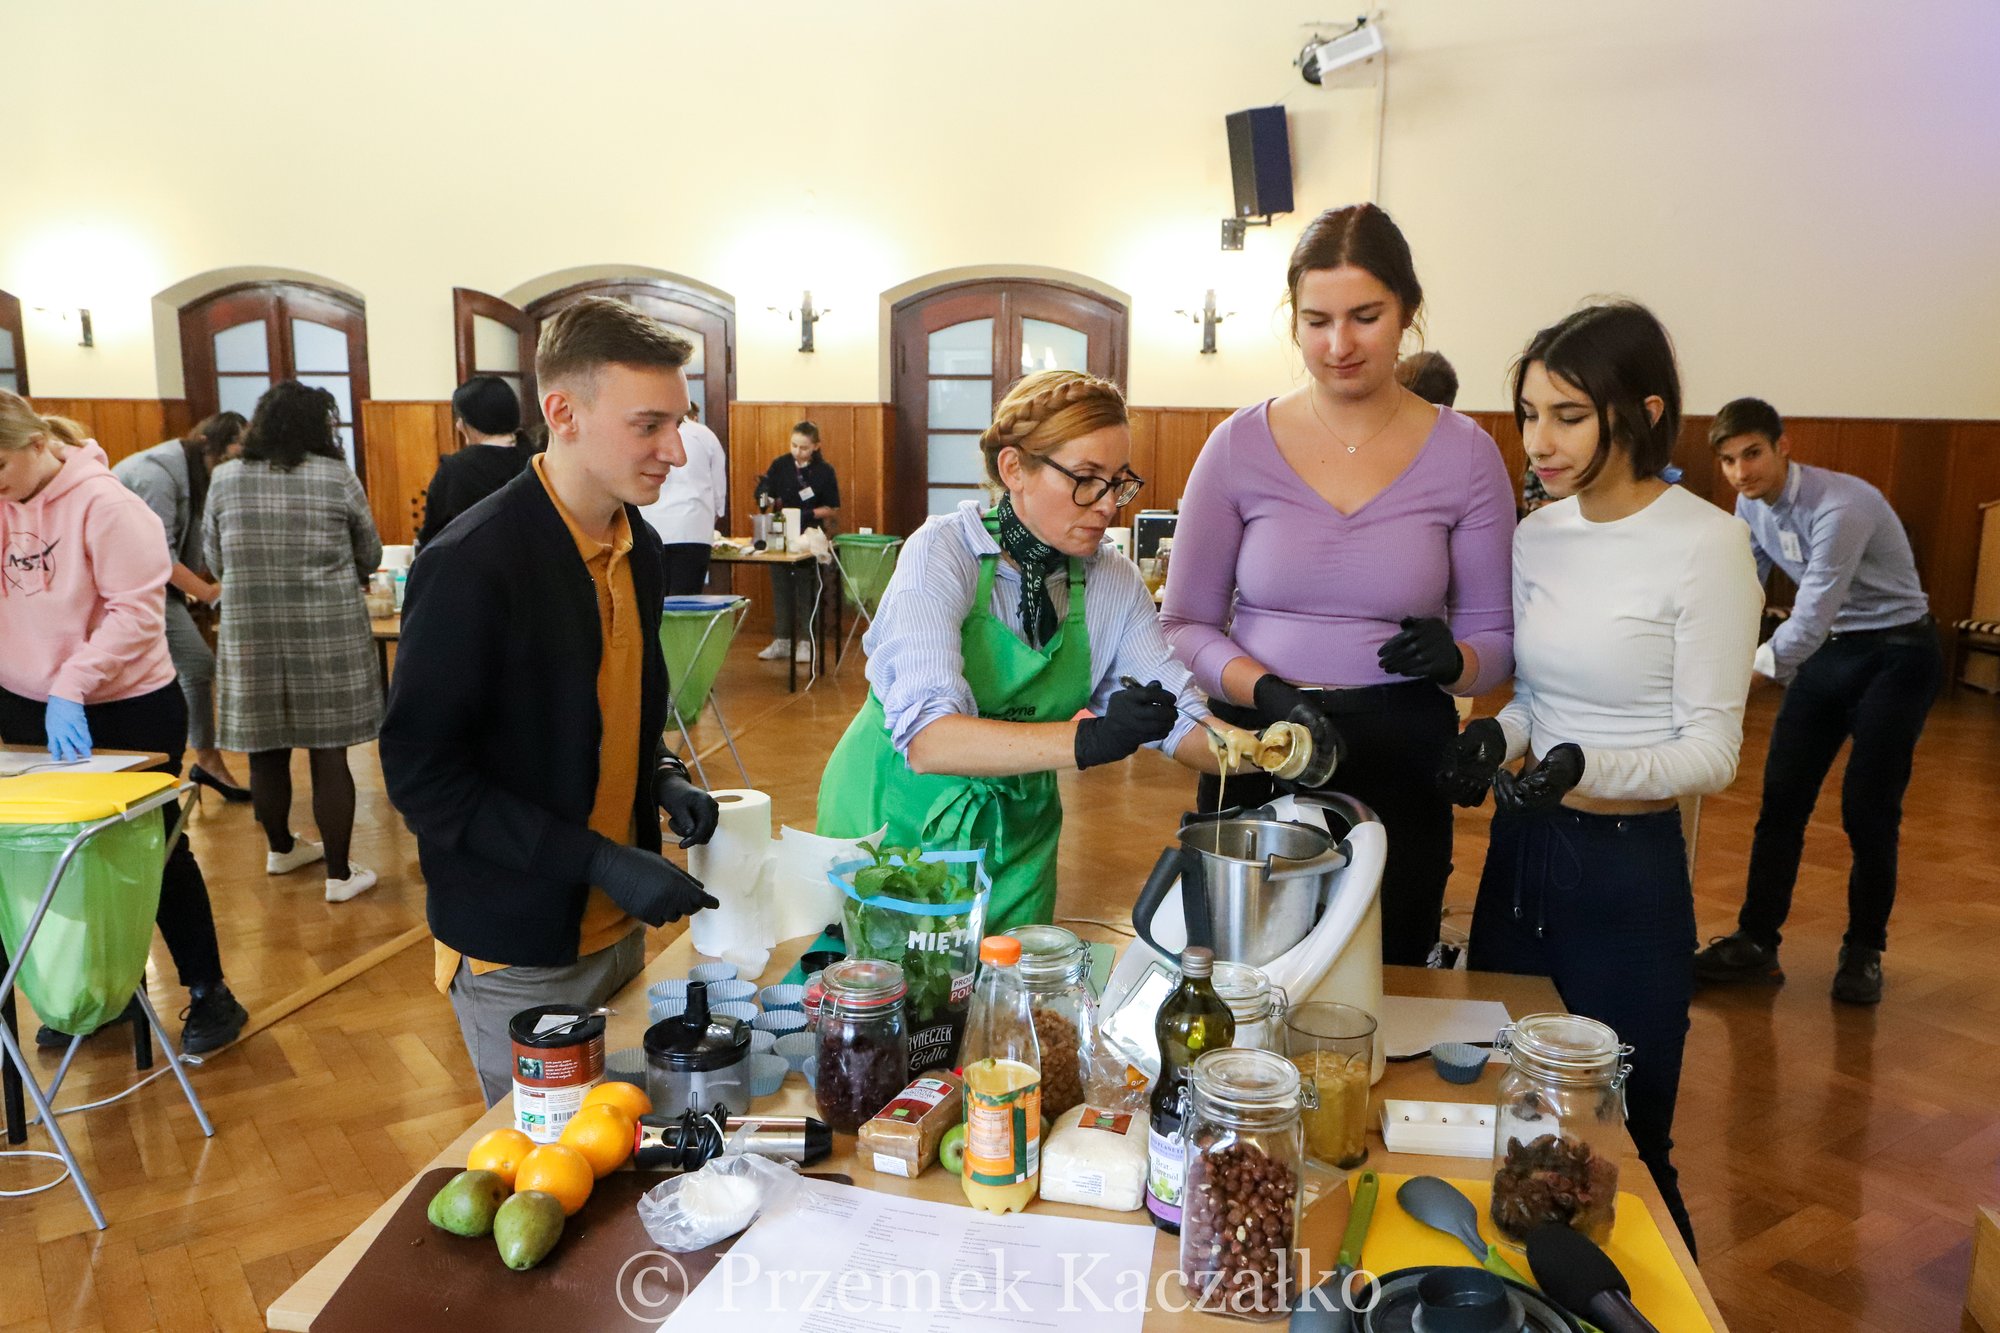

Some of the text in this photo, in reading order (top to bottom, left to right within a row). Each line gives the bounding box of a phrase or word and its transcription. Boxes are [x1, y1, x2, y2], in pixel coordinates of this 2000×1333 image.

[907, 930, 975, 955] MIĘTA
[953, 975, 974, 988] PROD
[910, 1045, 948, 1071] Lidla
